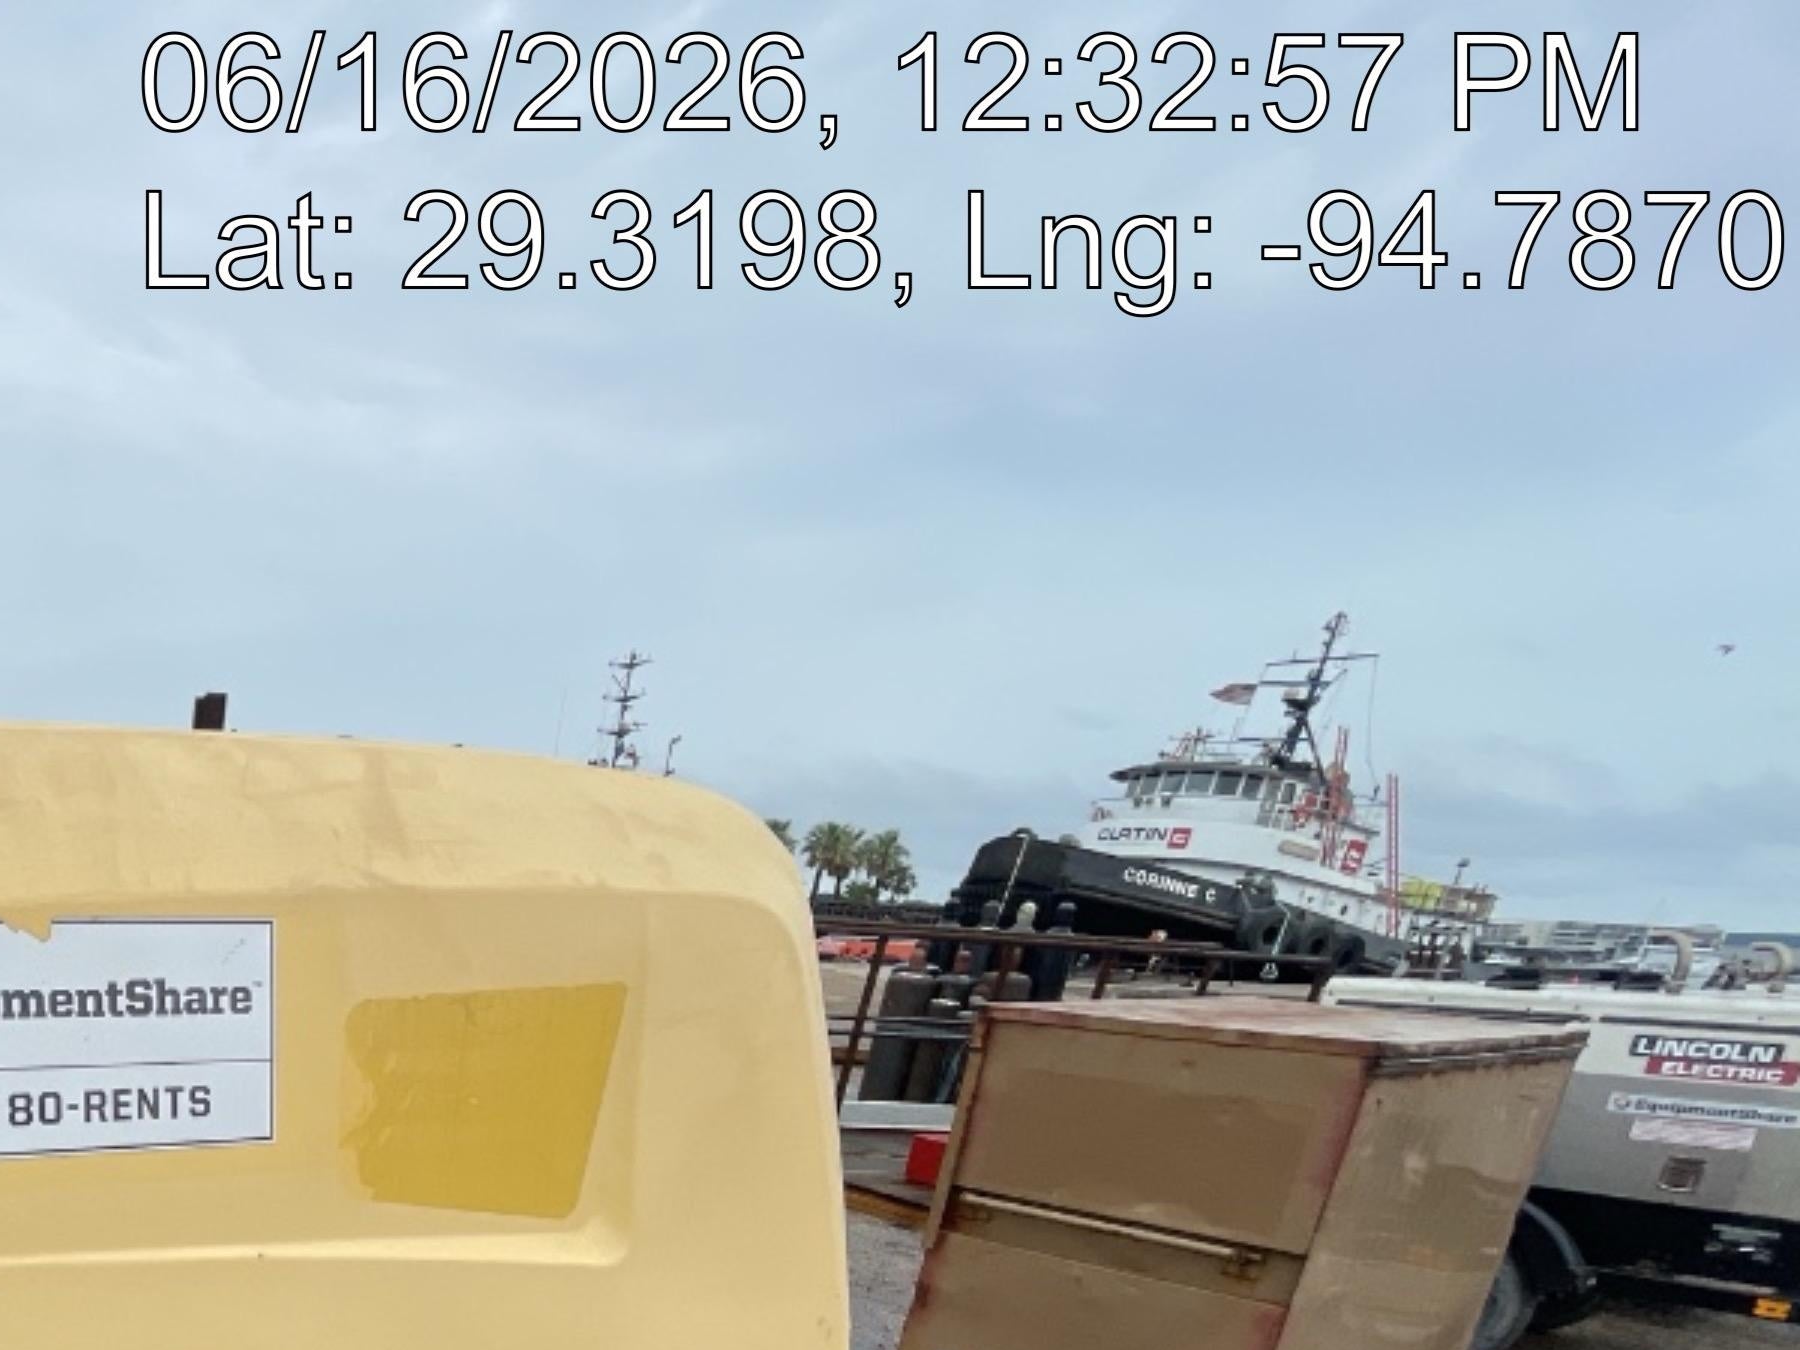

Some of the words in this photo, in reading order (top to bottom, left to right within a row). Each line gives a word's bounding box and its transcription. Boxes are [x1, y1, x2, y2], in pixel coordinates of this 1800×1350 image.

[1123, 866, 1199, 898] CORINNE
[1637, 1036, 1777, 1063] LINCOLN
[1660, 1060, 1785, 1083] ELECTRIC
[7, 1085, 212, 1127] 80-RENTS
